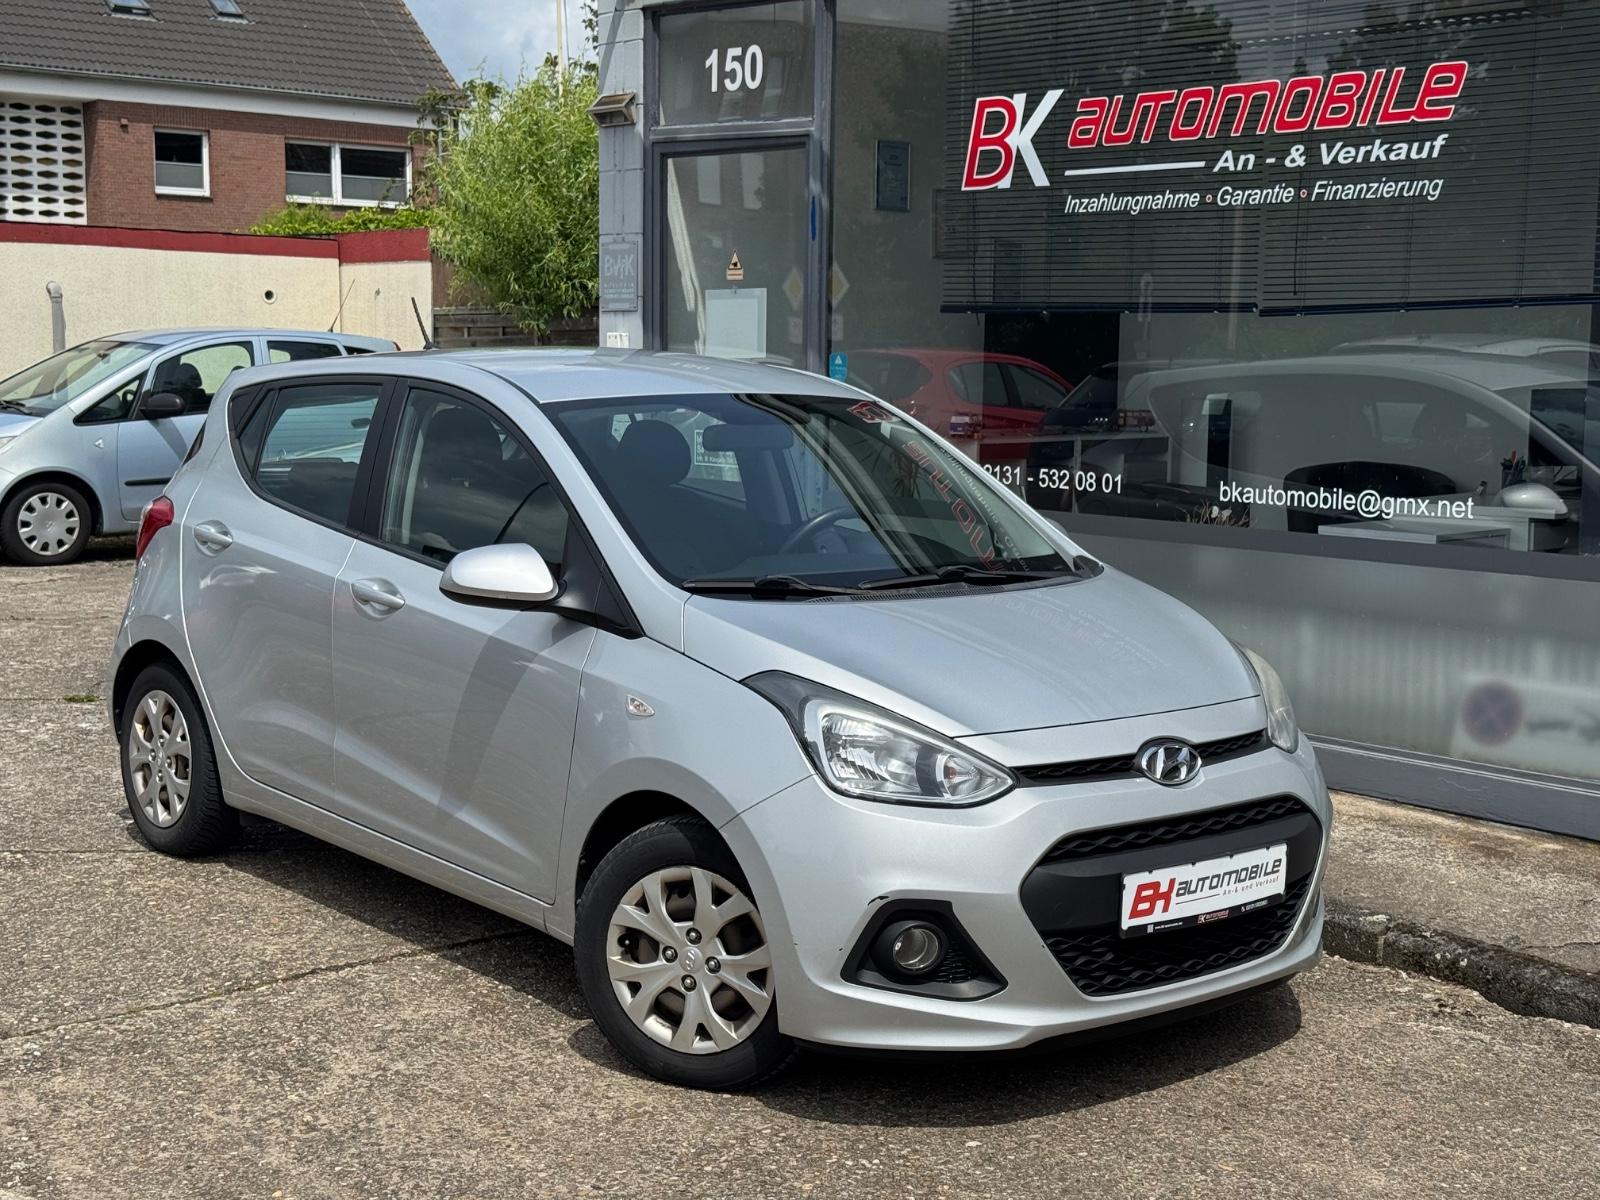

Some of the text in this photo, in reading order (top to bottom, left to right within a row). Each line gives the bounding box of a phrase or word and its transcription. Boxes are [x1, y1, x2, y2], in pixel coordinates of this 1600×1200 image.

[705, 44, 764, 92] 150
[962, 89, 1065, 191] BK
[1213, 150, 1256, 172] An
[1284, 145, 1307, 168] &
[1320, 134, 1449, 165] Verkauf
[1064, 178, 1444, 215] Inzahlungnahme Garantie Finanzierung
[1039, 468, 1070, 490] 532
[1075, 471, 1096, 491] 08
[1102, 473, 1121, 494] 01
[1219, 481, 1474, 519] bkautomobile@gmx.net
